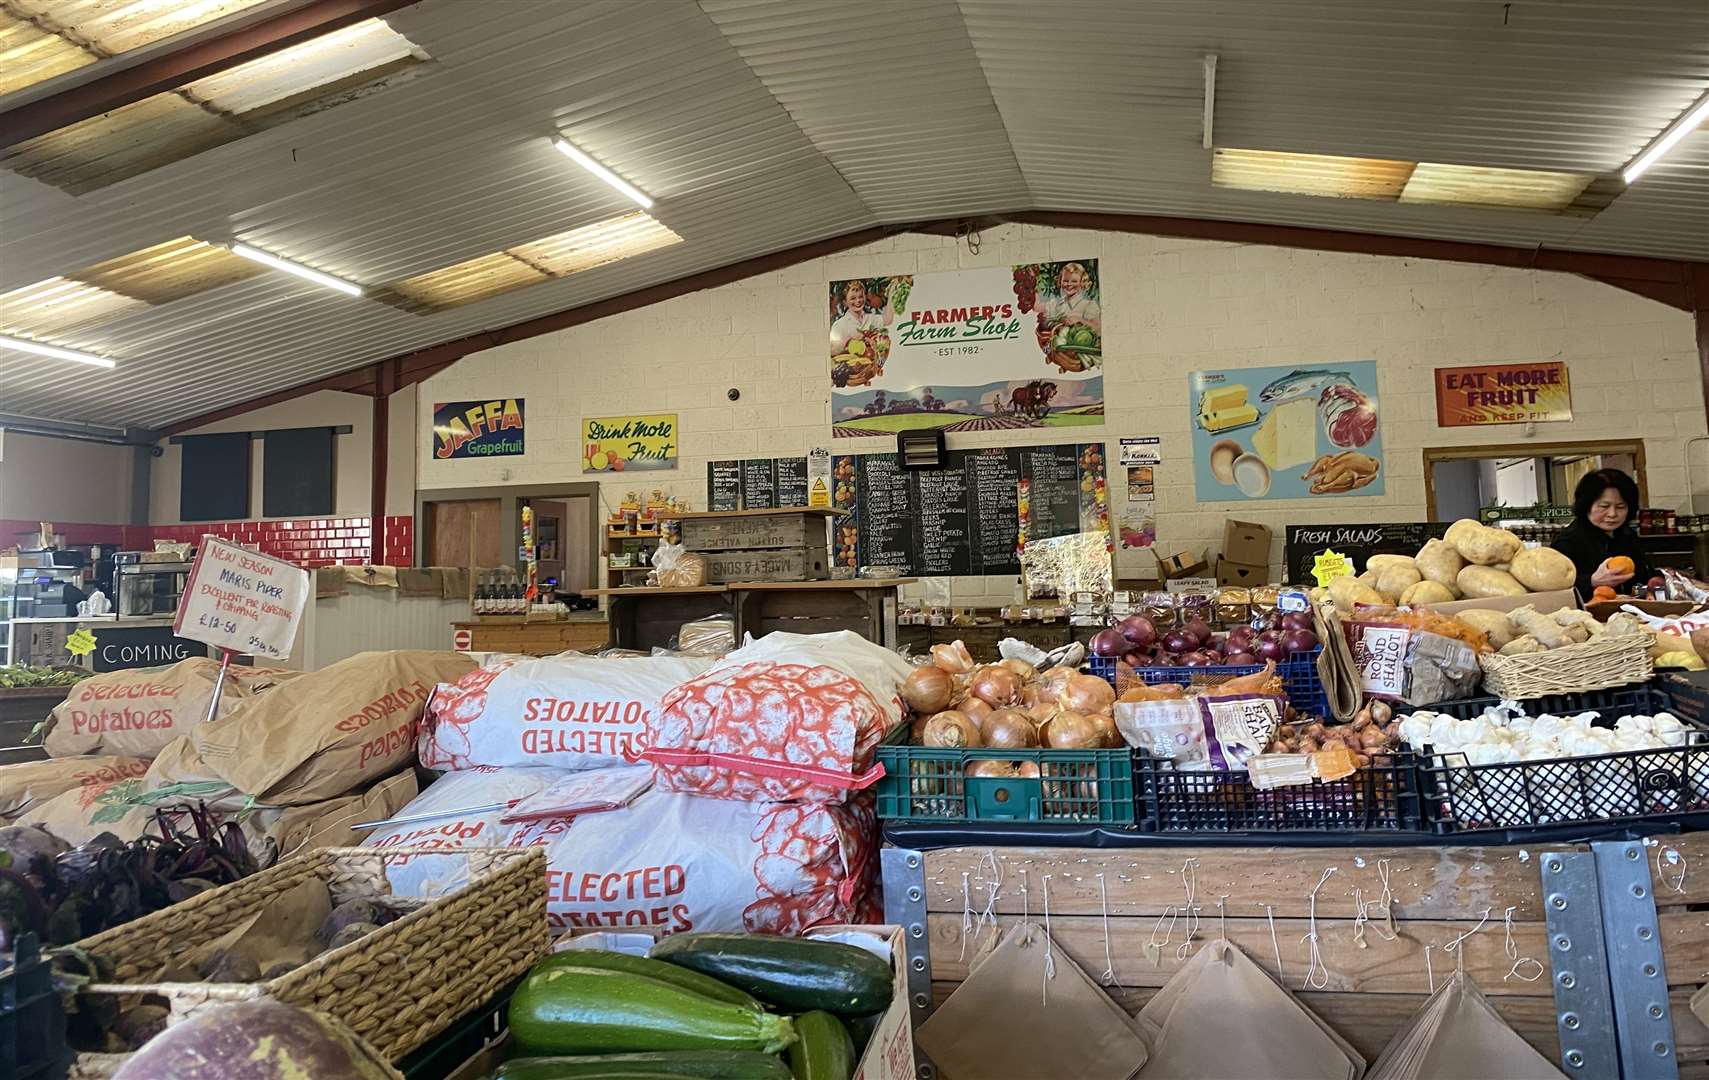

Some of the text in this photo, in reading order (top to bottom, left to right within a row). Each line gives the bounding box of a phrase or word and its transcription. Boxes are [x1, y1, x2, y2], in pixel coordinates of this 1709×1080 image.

[911, 304, 1013, 325] FARMER'S
[896, 316, 1022, 345] Farm Shop
[1446, 369, 1560, 390] EAT MORE
[1467, 388, 1539, 407] FRUIT
[1459, 411, 1550, 423] AND KEEP FIT
[434, 400, 523, 458] JAFFA
[588, 420, 673, 441] Drink More
[467, 440, 523, 455] Grapefruit
[627, 442, 675, 462] Fruit
[1542, 507, 1573, 517] SPICES
[924, 541, 942, 549] GARLIC
[1294, 529, 1331, 545] FRESH
[1333, 527, 1384, 545] SALADS
[211, 545, 274, 576] NEW SEASON
[201, 583, 246, 603] EXCELLENT
[220, 568, 283, 600] MARIS PIPER
[103, 644, 190, 664] COMING
[1370, 637, 1387, 680] ROUND
[1383, 634, 1401, 688] SHALLOT
[80, 681, 181, 702] Selected
[335, 681, 429, 734] Potatoes
[71, 706, 174, 736] Potatoes
[546, 864, 686, 902] ELECTED
[546, 904, 693, 936] OTATOES
